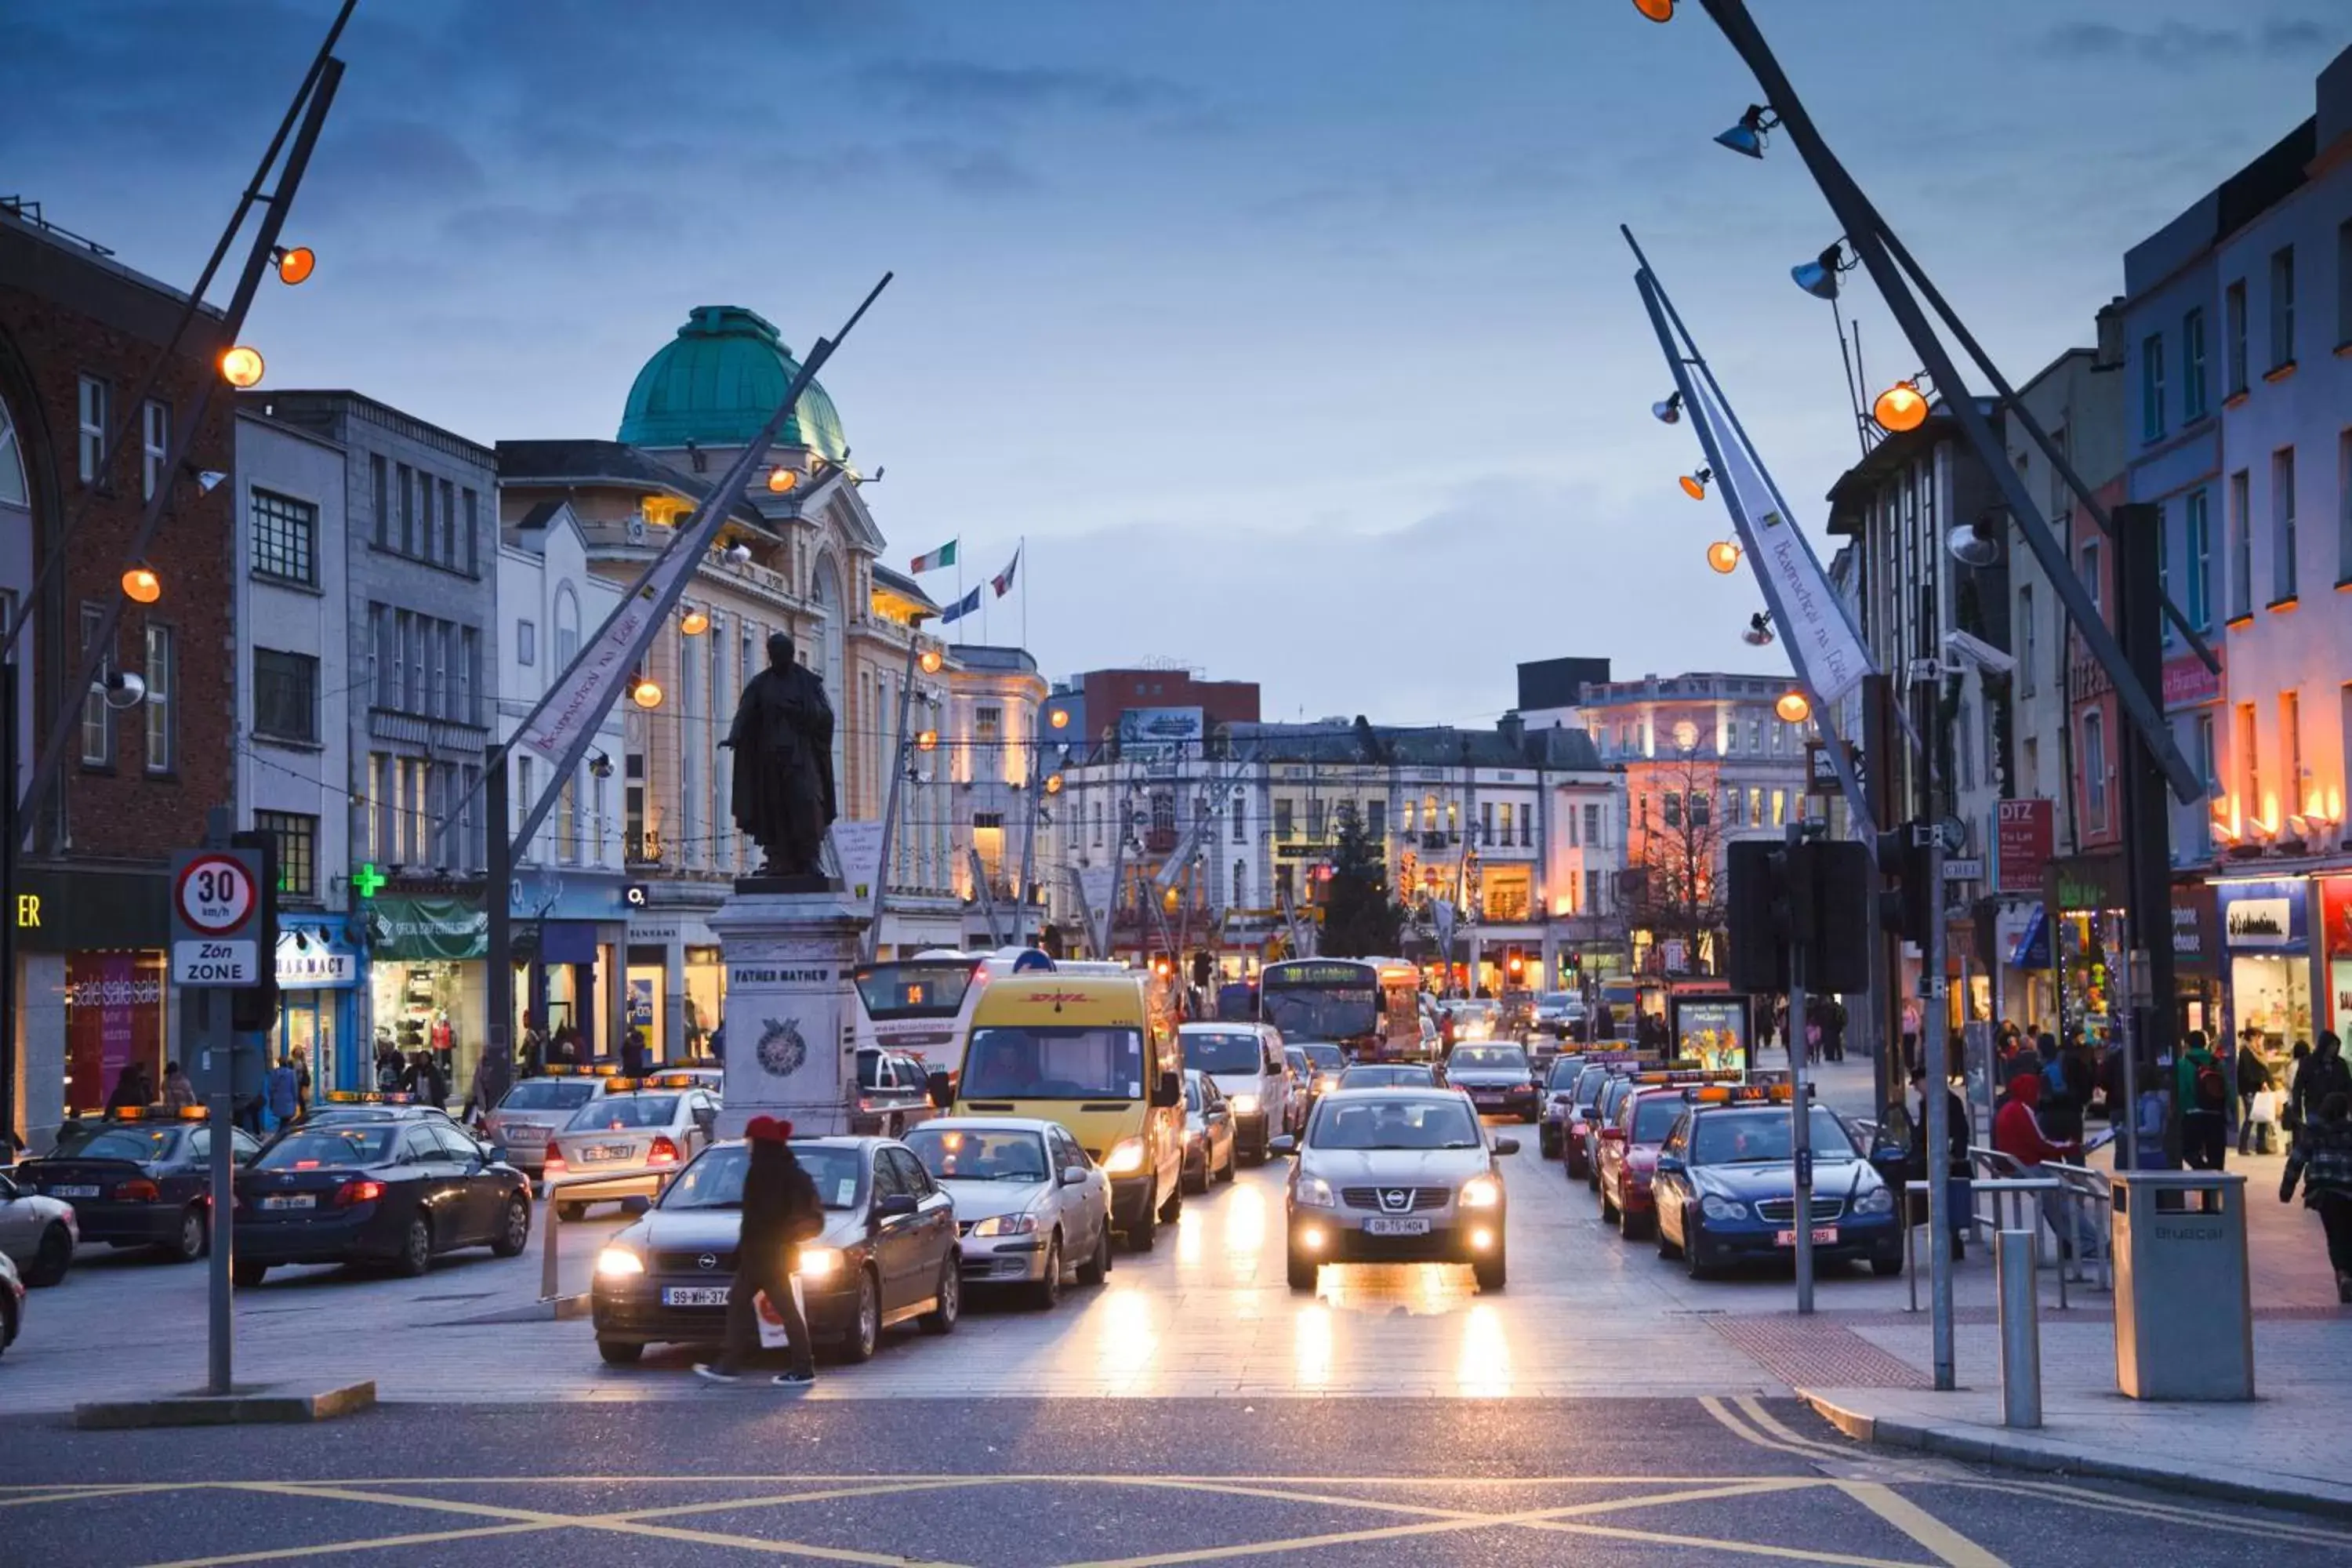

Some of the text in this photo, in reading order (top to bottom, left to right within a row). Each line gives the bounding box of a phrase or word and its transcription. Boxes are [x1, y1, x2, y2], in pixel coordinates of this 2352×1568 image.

[1999, 803, 2033, 820] DTZ
[198, 870, 234, 902] 30
[18, 895, 41, 927] ER
[202, 907, 230, 917] km/h
[187, 965, 242, 979] ZONE
[735, 970, 828, 983] FATHER MATHEW
[1028, 993, 1088, 1002] DHL
[1737, 1086, 1762, 1098] TAXI
